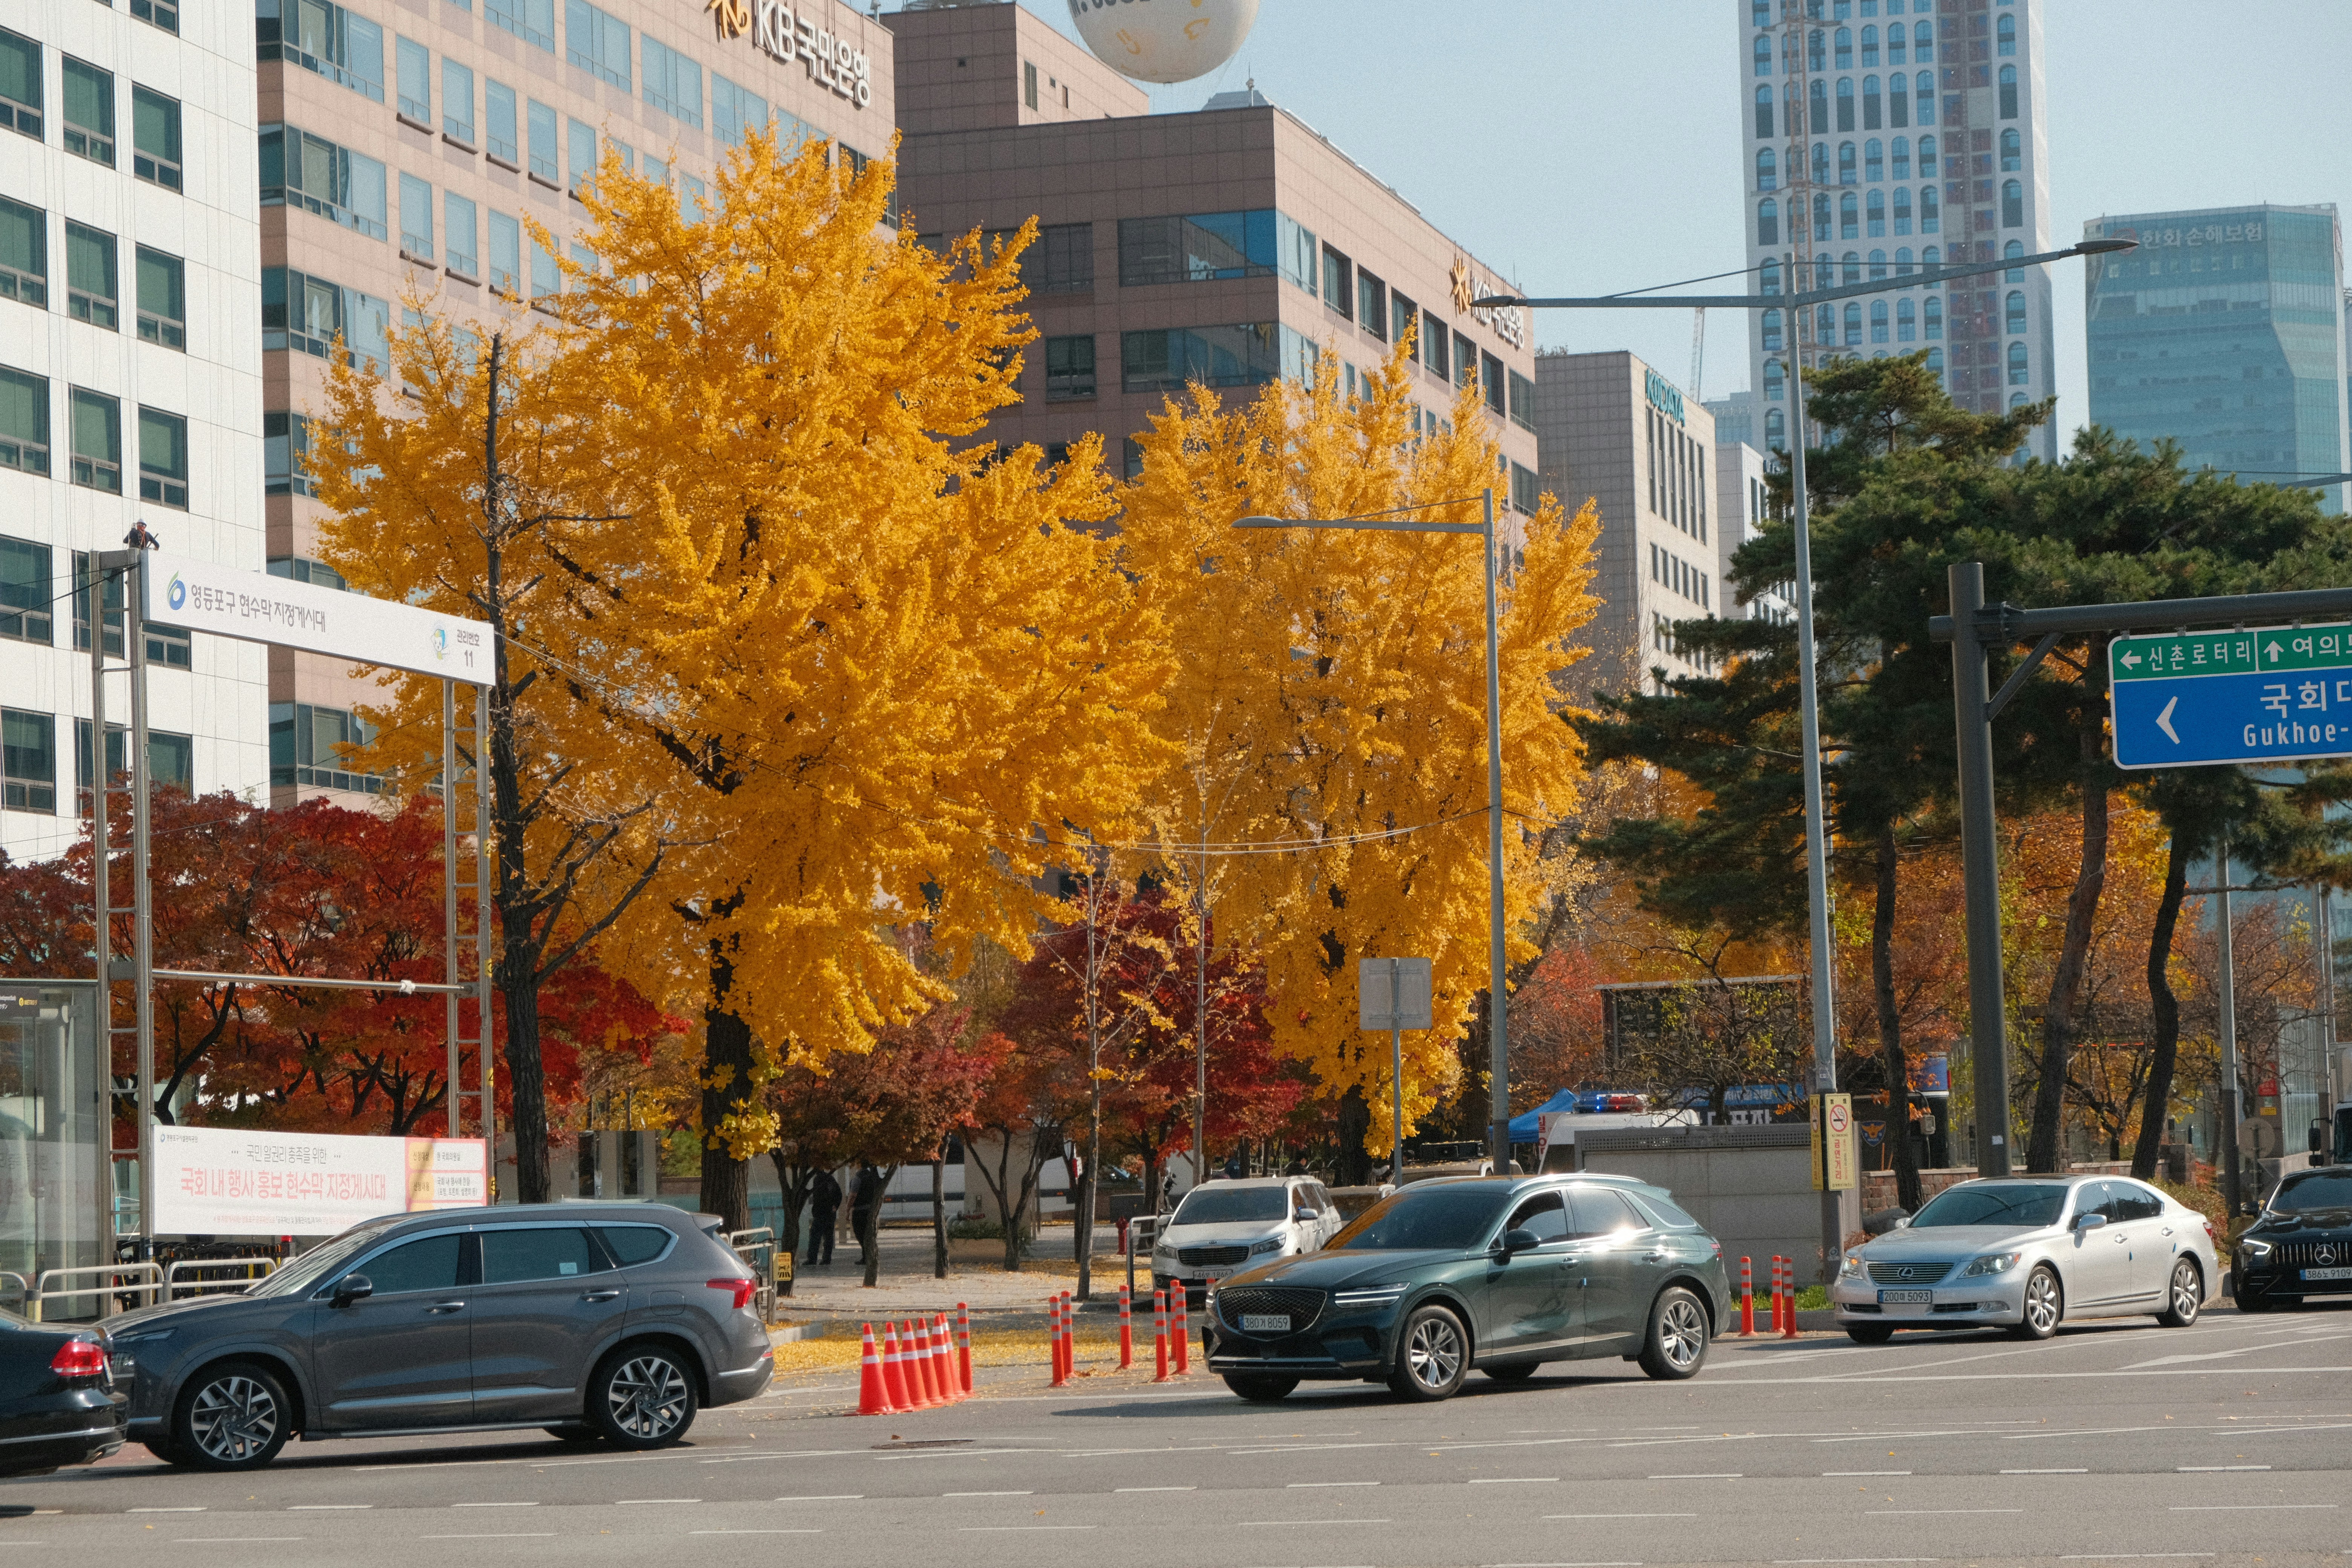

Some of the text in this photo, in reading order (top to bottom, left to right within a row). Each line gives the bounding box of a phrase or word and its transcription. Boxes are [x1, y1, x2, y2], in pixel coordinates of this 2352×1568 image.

[191, 584, 326, 633] 영등포구 현수막 지정게시대
[457, 629, 480, 646] 관리번호
[464, 649, 473, 668] 11
[2148, 640, 2250, 671] 신촌로터리
[247, 1144, 327, 1164] 국민 알권리 충족을 위한
[181, 1167, 386, 1200] 국회 내 행사 홍보 현수막 지정게시대
[2307, 1269, 2351, 1279] 386노 9109
[1885, 1292, 1929, 1302] 200마 5093
[1268, 1317, 1288, 1328] 8059
